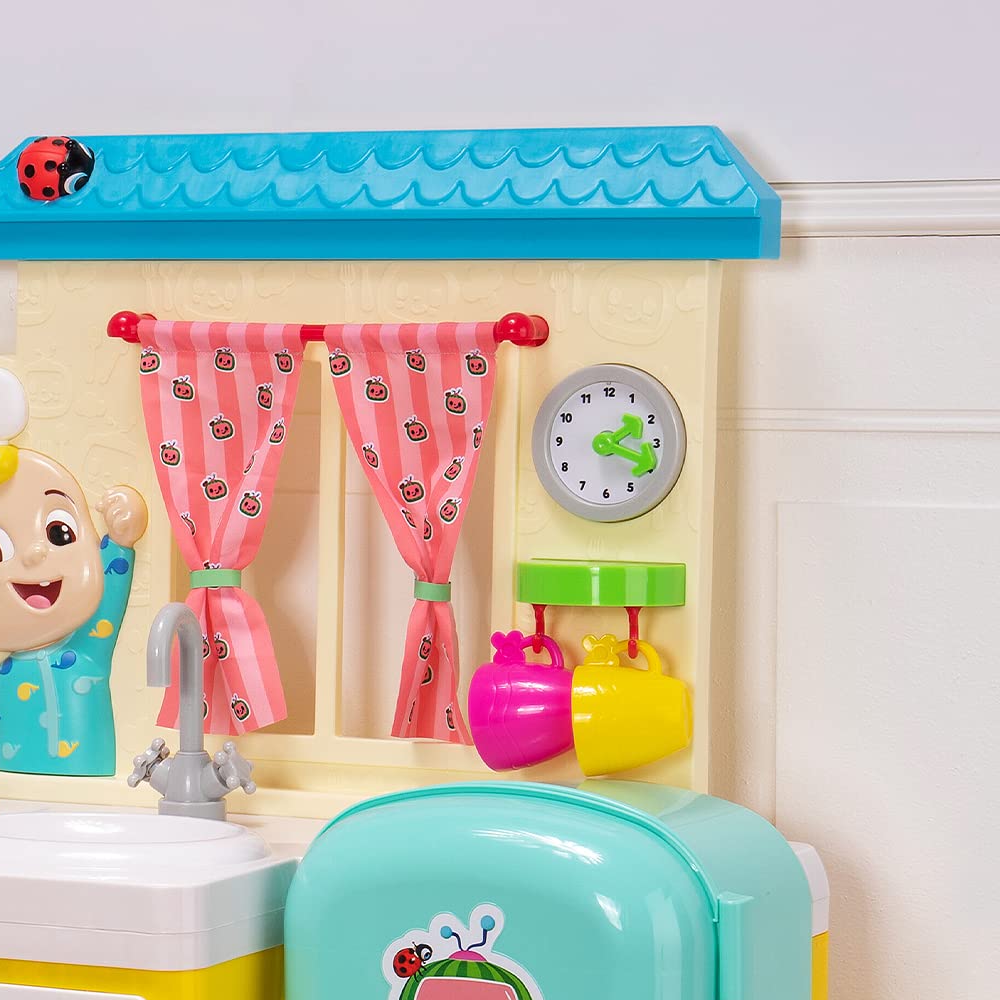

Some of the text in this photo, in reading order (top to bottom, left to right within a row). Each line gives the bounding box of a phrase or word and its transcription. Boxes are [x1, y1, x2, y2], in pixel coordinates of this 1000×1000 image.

[603, 387, 616, 398] 12
[580, 393, 591, 404] 11
[628, 393, 635, 404] 1
[560, 412, 573, 424] 10
[647, 414, 656, 425] 2
[555, 436, 563, 447] 9
[652, 438, 661, 449] 3
[561, 461, 569, 472] 8
[579, 480, 586, 491] 7
[626, 482, 634, 493] 5
[602, 488, 610, 499] 6
